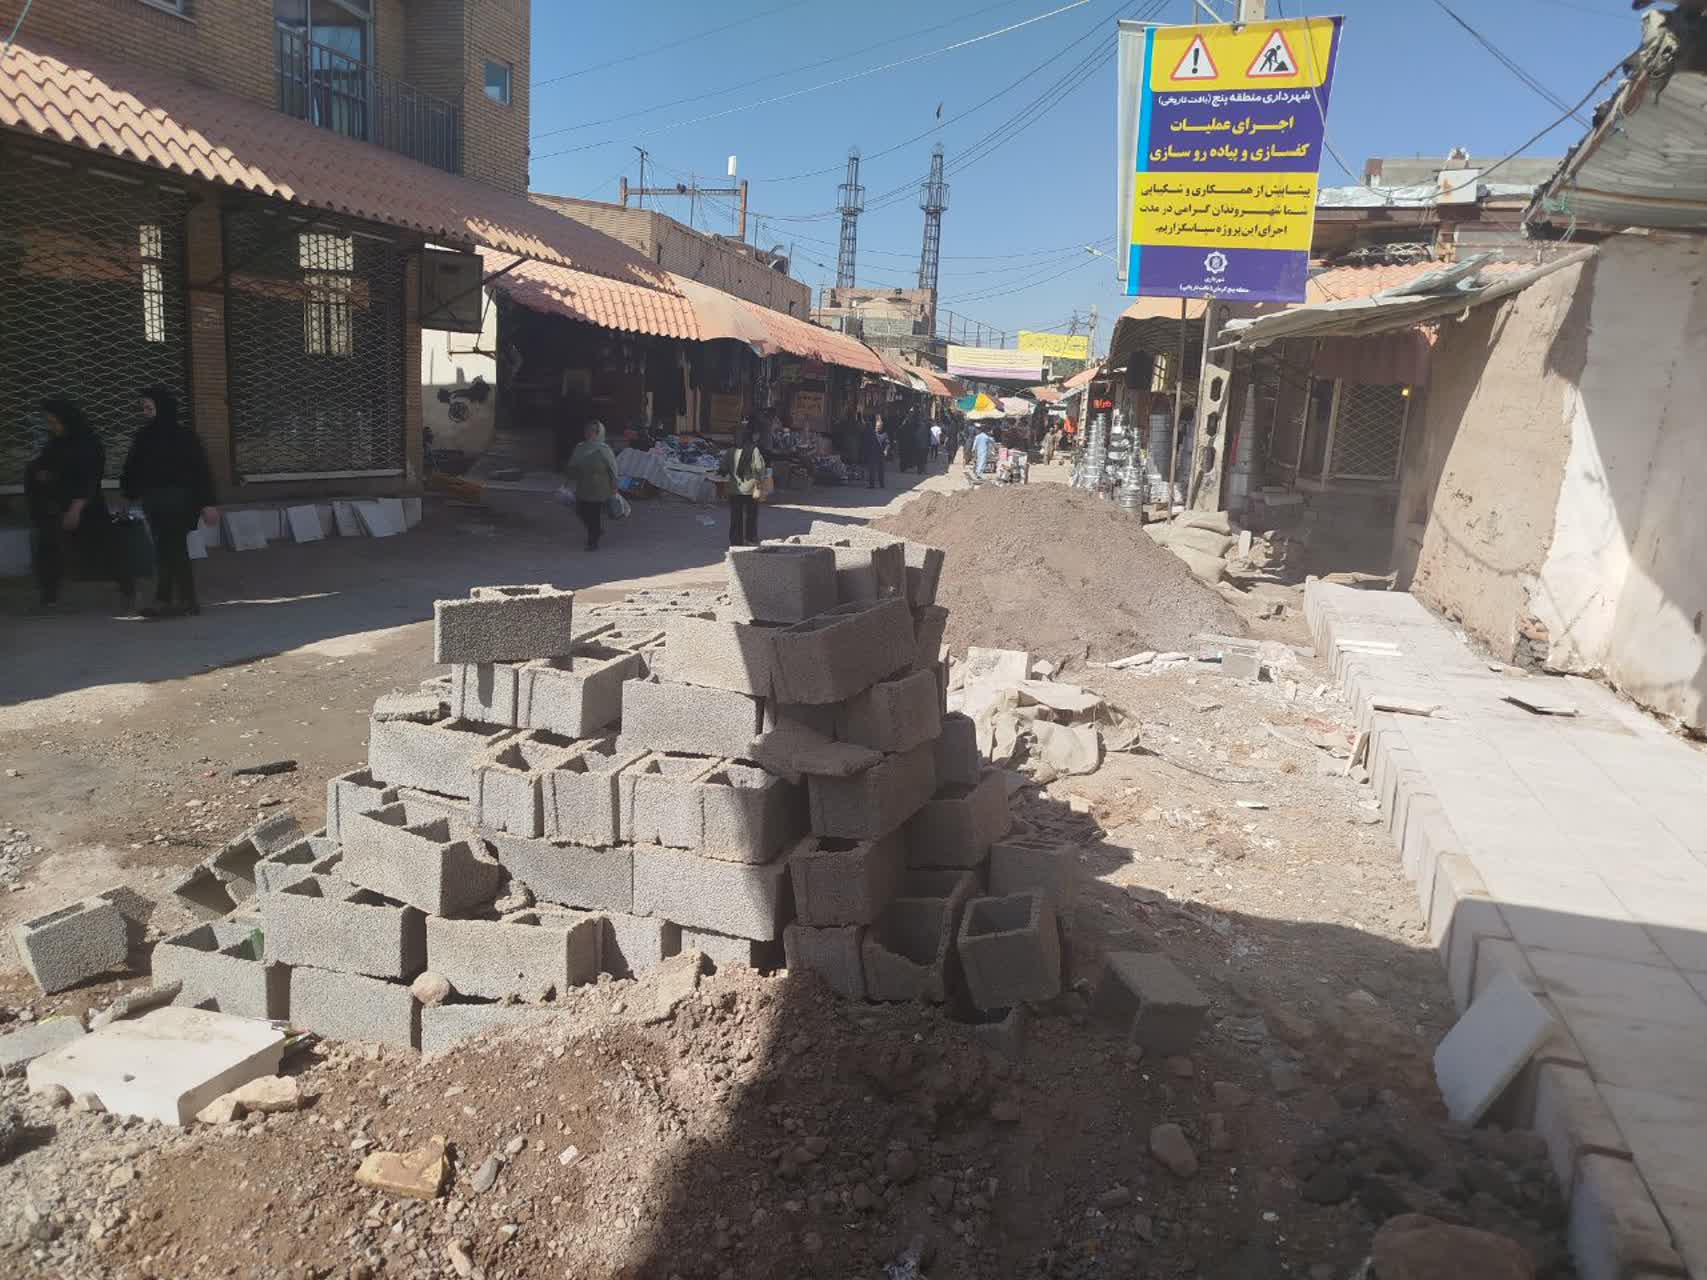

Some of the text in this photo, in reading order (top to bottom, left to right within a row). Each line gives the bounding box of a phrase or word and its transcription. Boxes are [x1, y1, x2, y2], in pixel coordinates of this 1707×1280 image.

[1211, 94, 1228, 107] پنج
[1229, 92, 1261, 102] منطقه
[1262, 91, 1311, 104] شهرداری
[1170, 116, 1294, 135] اجرای عملیات
[1209, 144, 1239, 161] پیاده
[1191, 184, 1253, 197] همکاری
[1253, 186, 1264, 198] از
[1162, 204, 1173, 215] در
[1212, 205, 1281, 217] شهروندان
[1283, 204, 1308, 216] شما
[1242, 224, 1258, 236] این
[1258, 225, 1288, 237] اجرای
